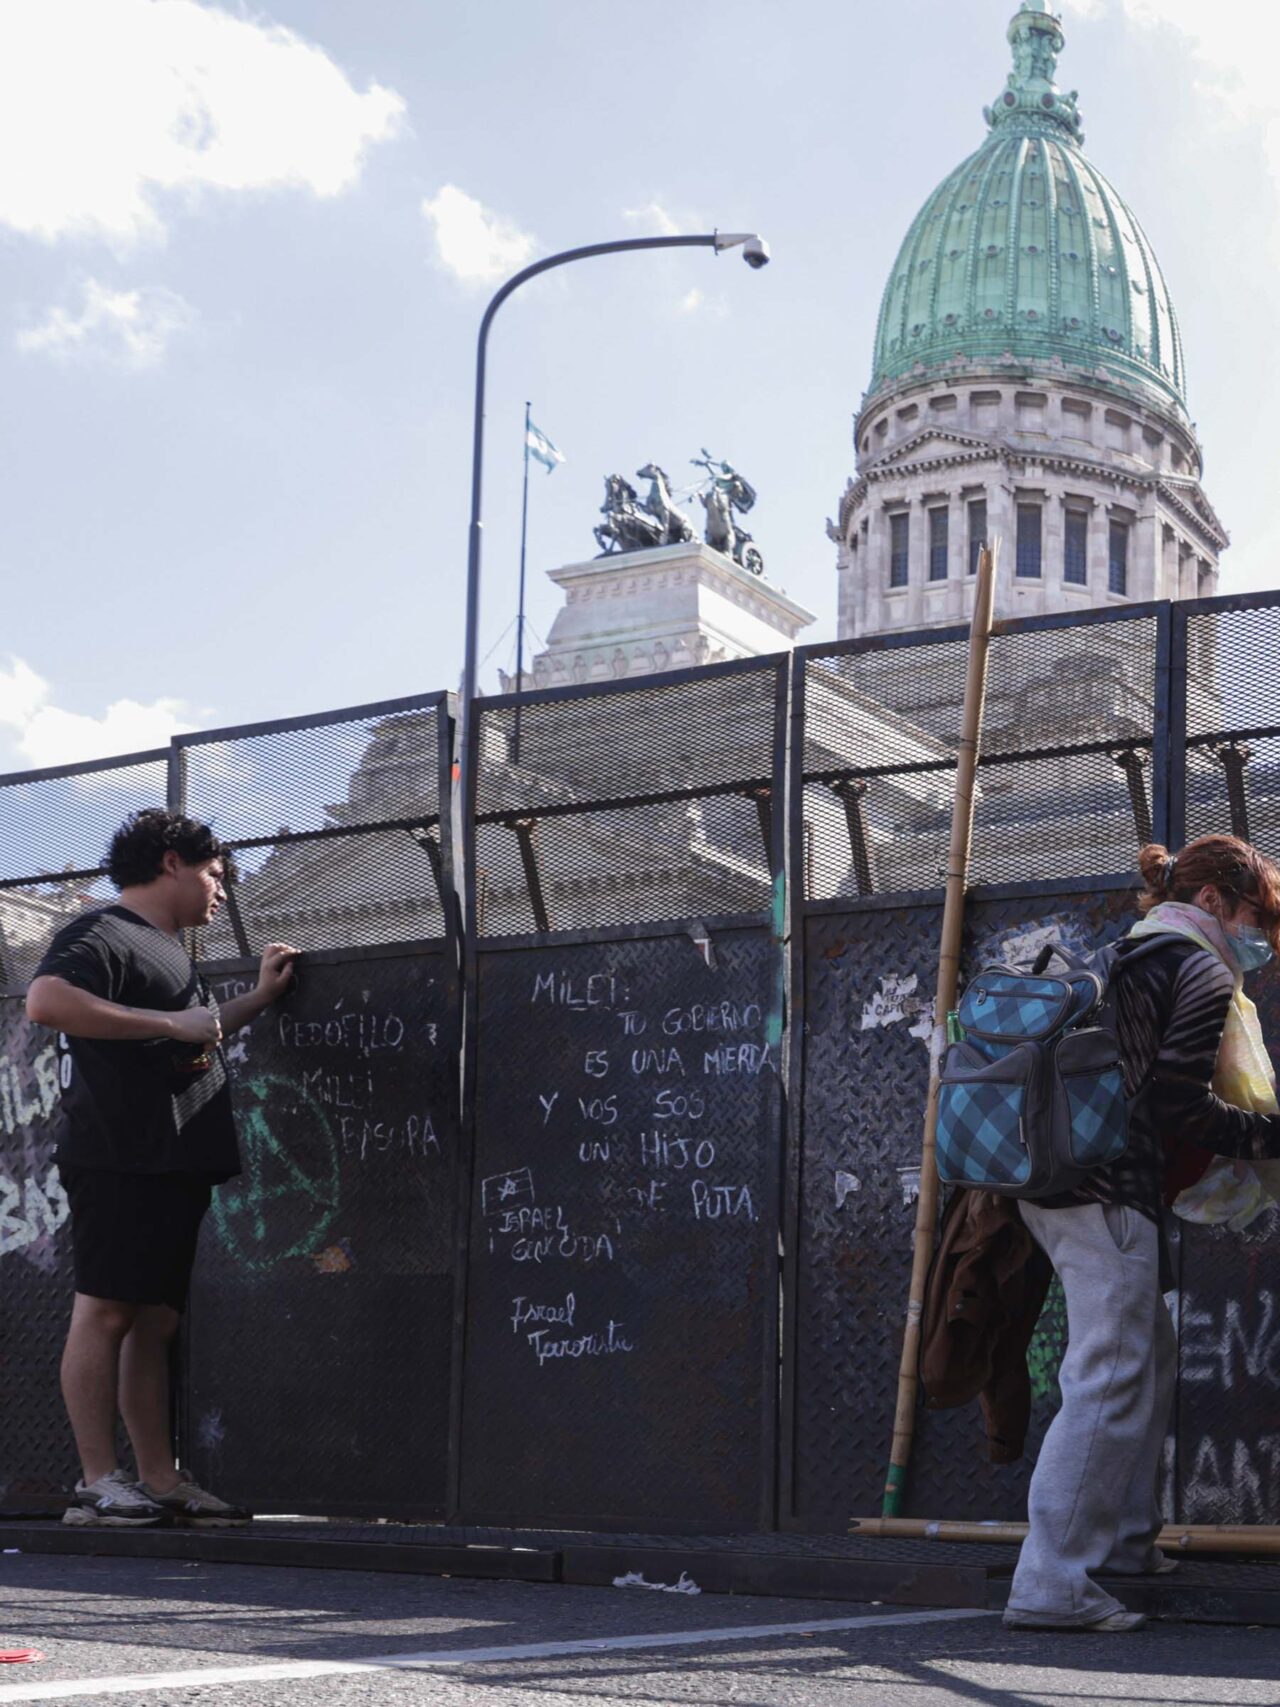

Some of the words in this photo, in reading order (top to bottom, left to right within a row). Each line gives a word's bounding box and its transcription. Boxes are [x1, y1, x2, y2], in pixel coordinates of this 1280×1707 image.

[662, 1000, 761, 1036] GOBIERNO
[585, 1050, 609, 1078] ES
[631, 1048, 686, 1078] UNA
[538, 1091, 559, 1126] Y
[578, 1094, 617, 1126] VOS
[653, 1090, 705, 1120] SOS
[510, 1292, 576, 1333] Israel
